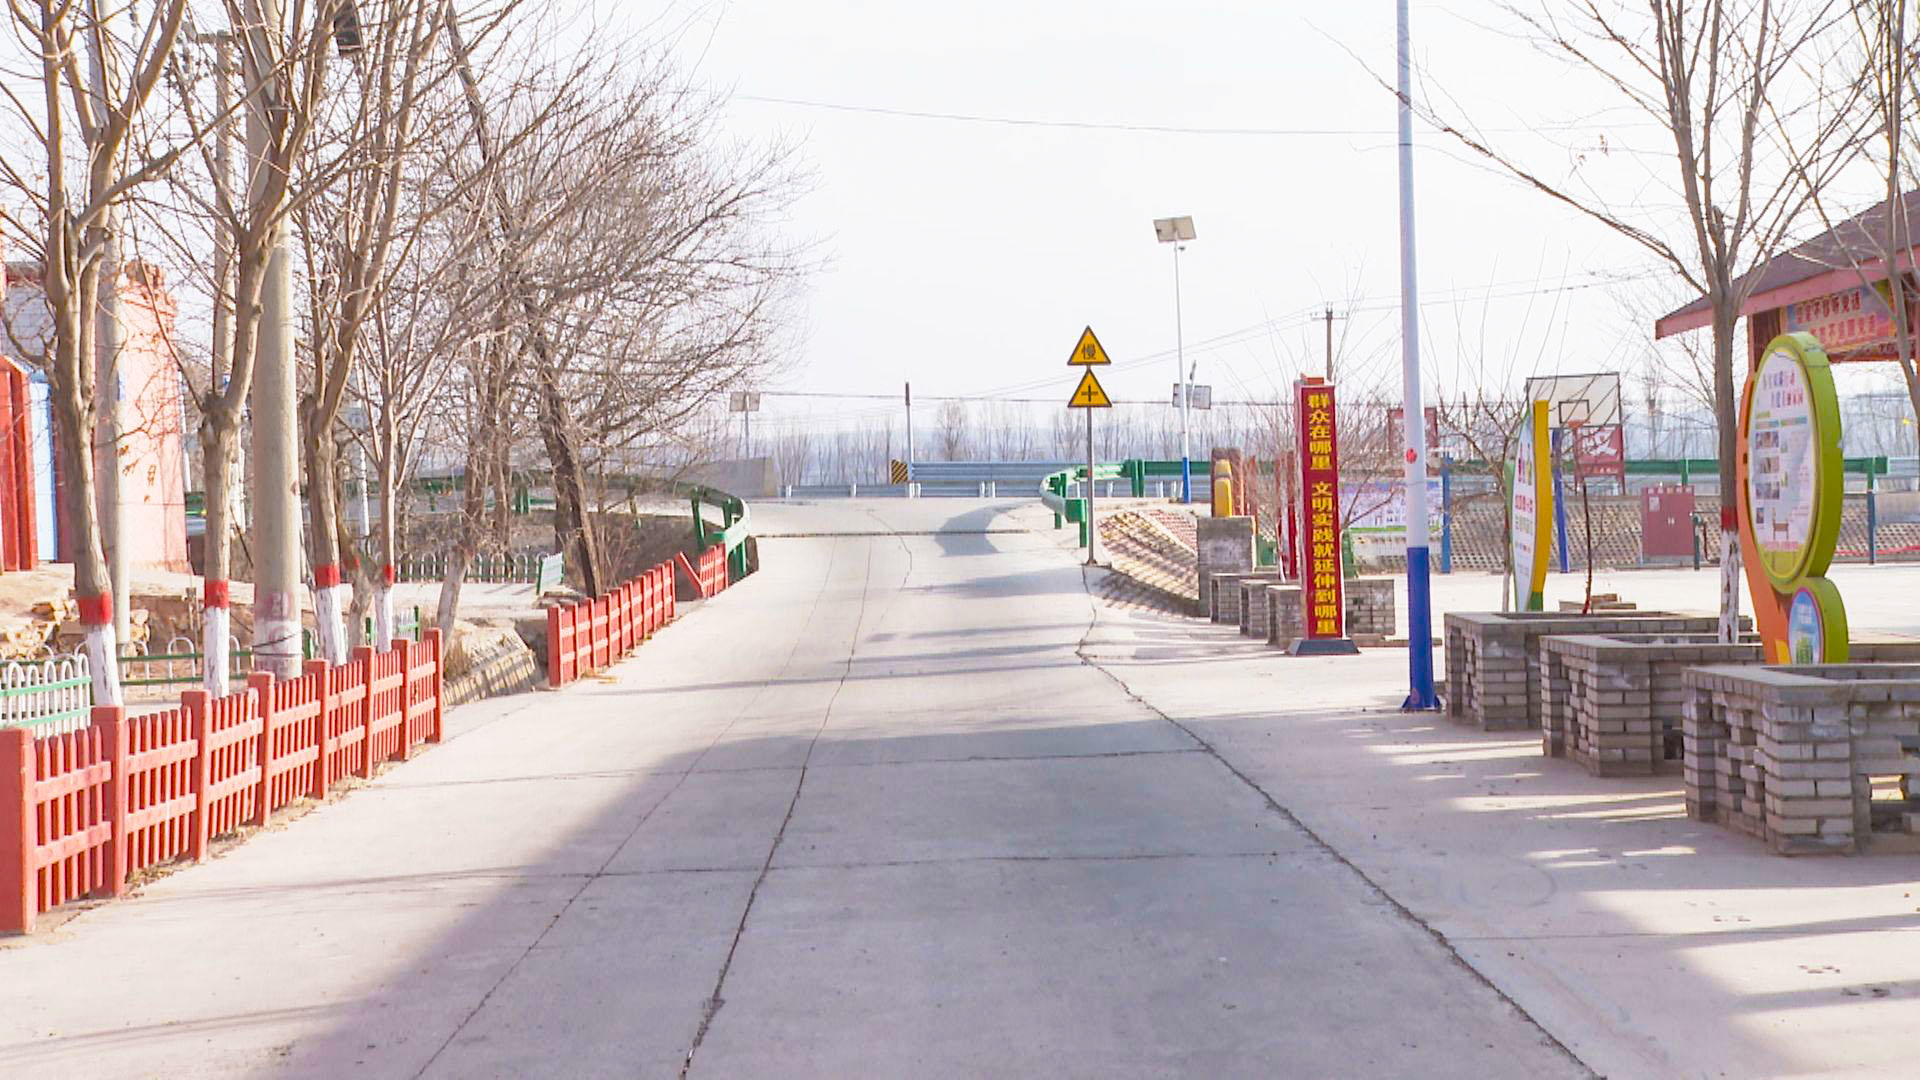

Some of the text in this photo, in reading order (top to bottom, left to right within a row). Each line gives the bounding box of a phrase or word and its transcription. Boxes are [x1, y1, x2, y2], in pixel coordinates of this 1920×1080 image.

[1081, 343, 1096, 360] 慢
[1307, 394, 1338, 634] 群众在哪里 文明实践就延伸到哪里
